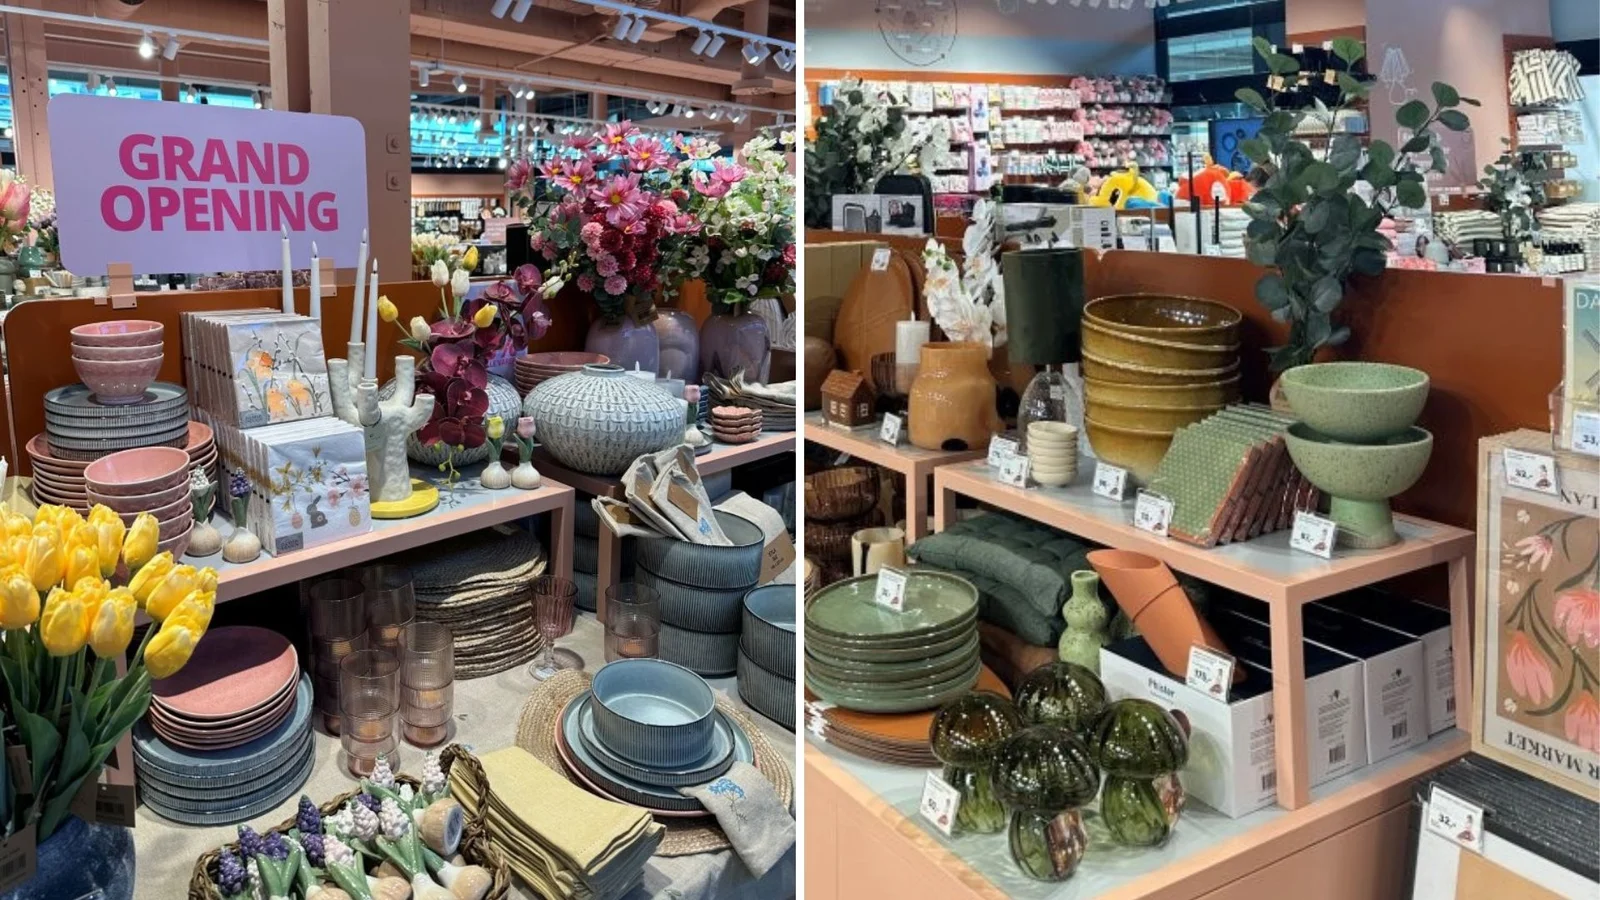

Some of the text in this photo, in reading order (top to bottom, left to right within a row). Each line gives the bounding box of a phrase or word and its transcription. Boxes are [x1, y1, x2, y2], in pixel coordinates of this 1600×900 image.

[119, 133, 310, 185] GRAND
[100, 184, 339, 232] OPENING
[1505, 731, 1582, 774] MARKET
